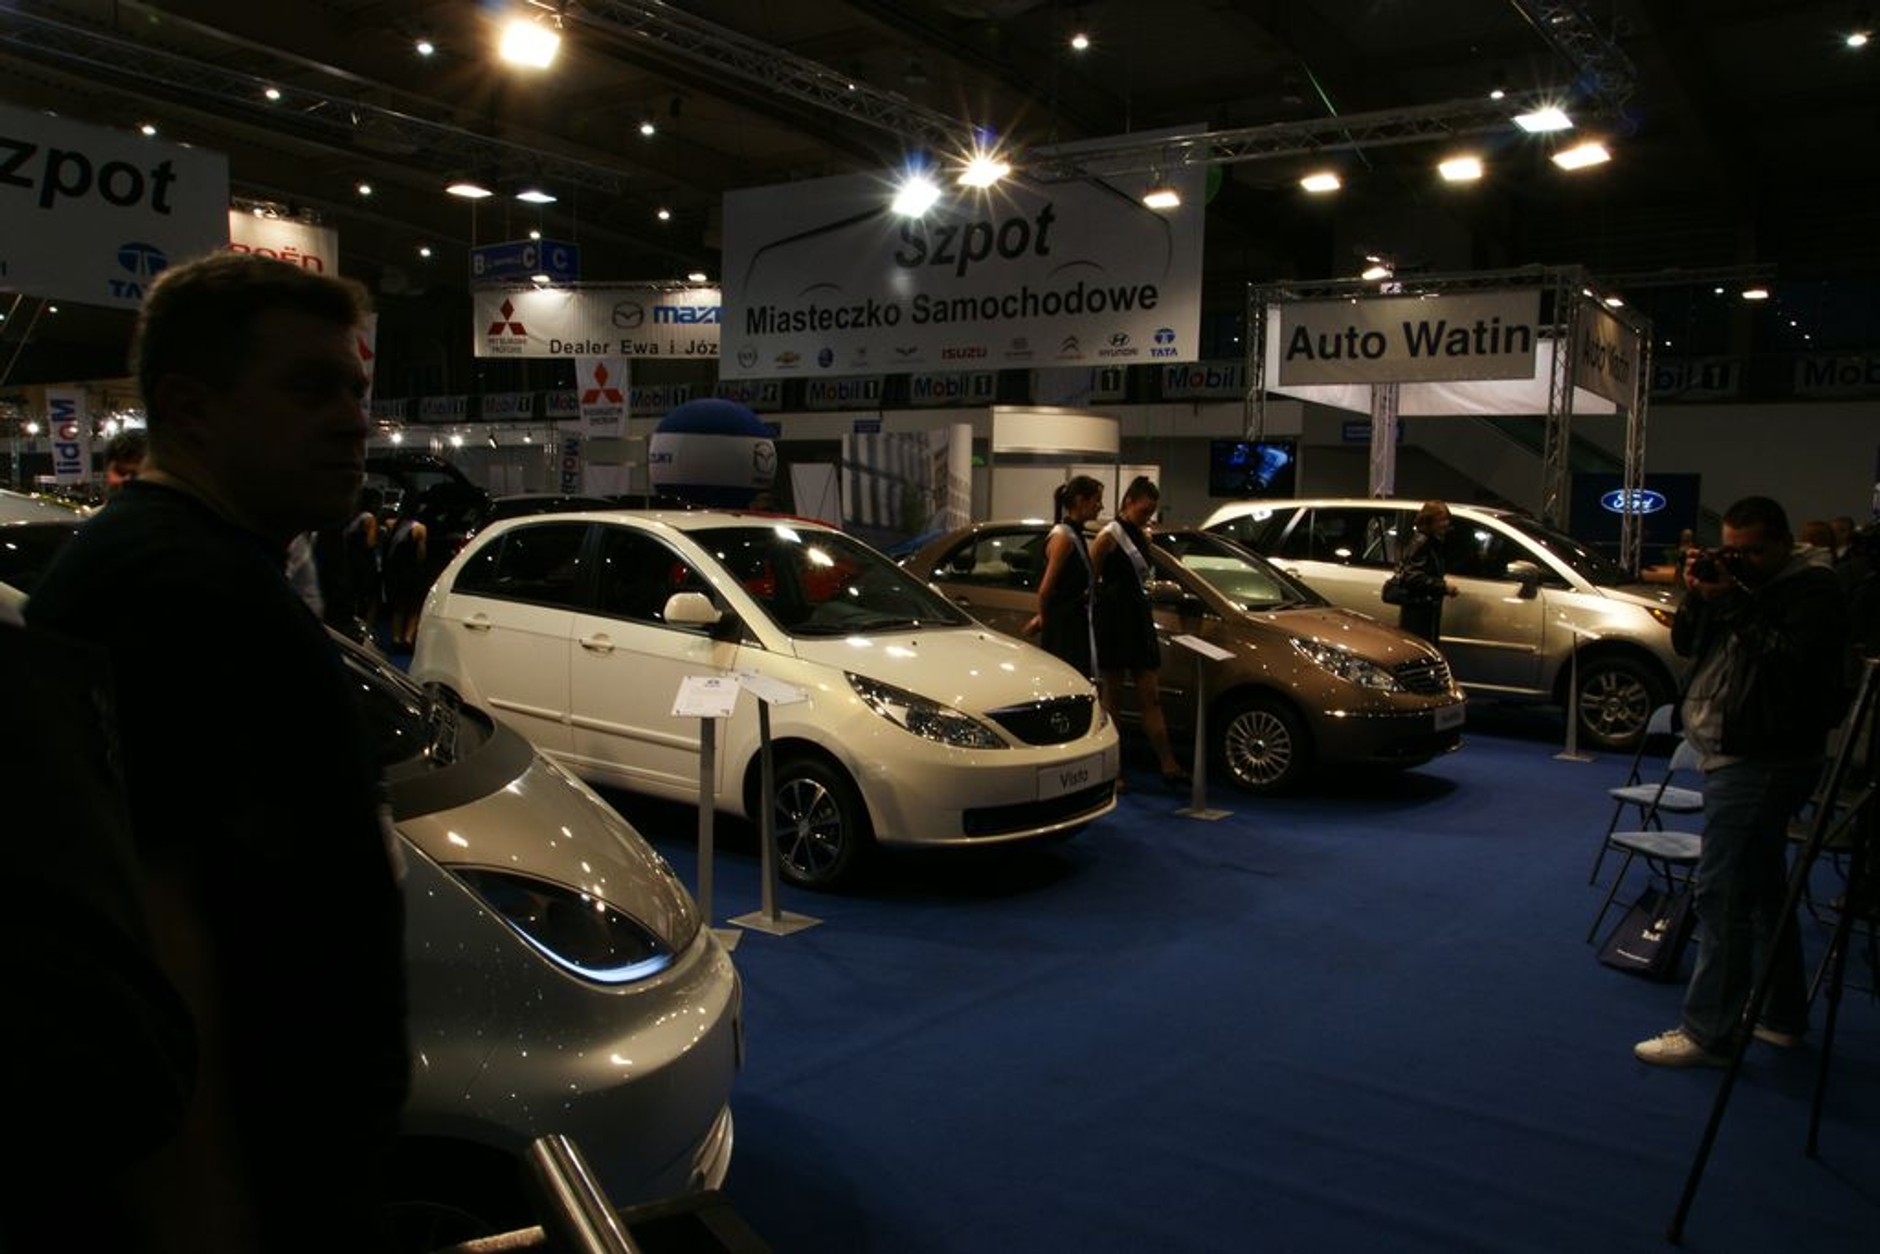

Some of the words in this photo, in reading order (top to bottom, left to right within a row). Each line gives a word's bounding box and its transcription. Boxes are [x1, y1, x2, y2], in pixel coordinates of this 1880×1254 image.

[0, 136, 177, 216] zpot
[896, 202, 1055, 277] Szpot
[474, 255, 486, 275] B
[523, 246, 537, 268] C
[552, 247, 569, 270] C
[109, 279, 143, 298] TA
[746, 300, 901, 335] Miasteczko
[912, 281, 1159, 325] Samochodowe
[550, 339, 610, 354] Dealer
[621, 340, 659, 354] Ewa
[670, 340, 675, 354] i
[1287, 324, 1387, 362] Auto
[1404, 317, 1531, 358] Watin
[942, 346, 988, 359] ISUZU
[1150, 348, 1178, 358] TATA
[914, 373, 969, 399] Mobil
[1168, 366, 1235, 389] Mobil
[811, 381, 859, 401] Mobil
[51, 399, 81, 474] Mobil
